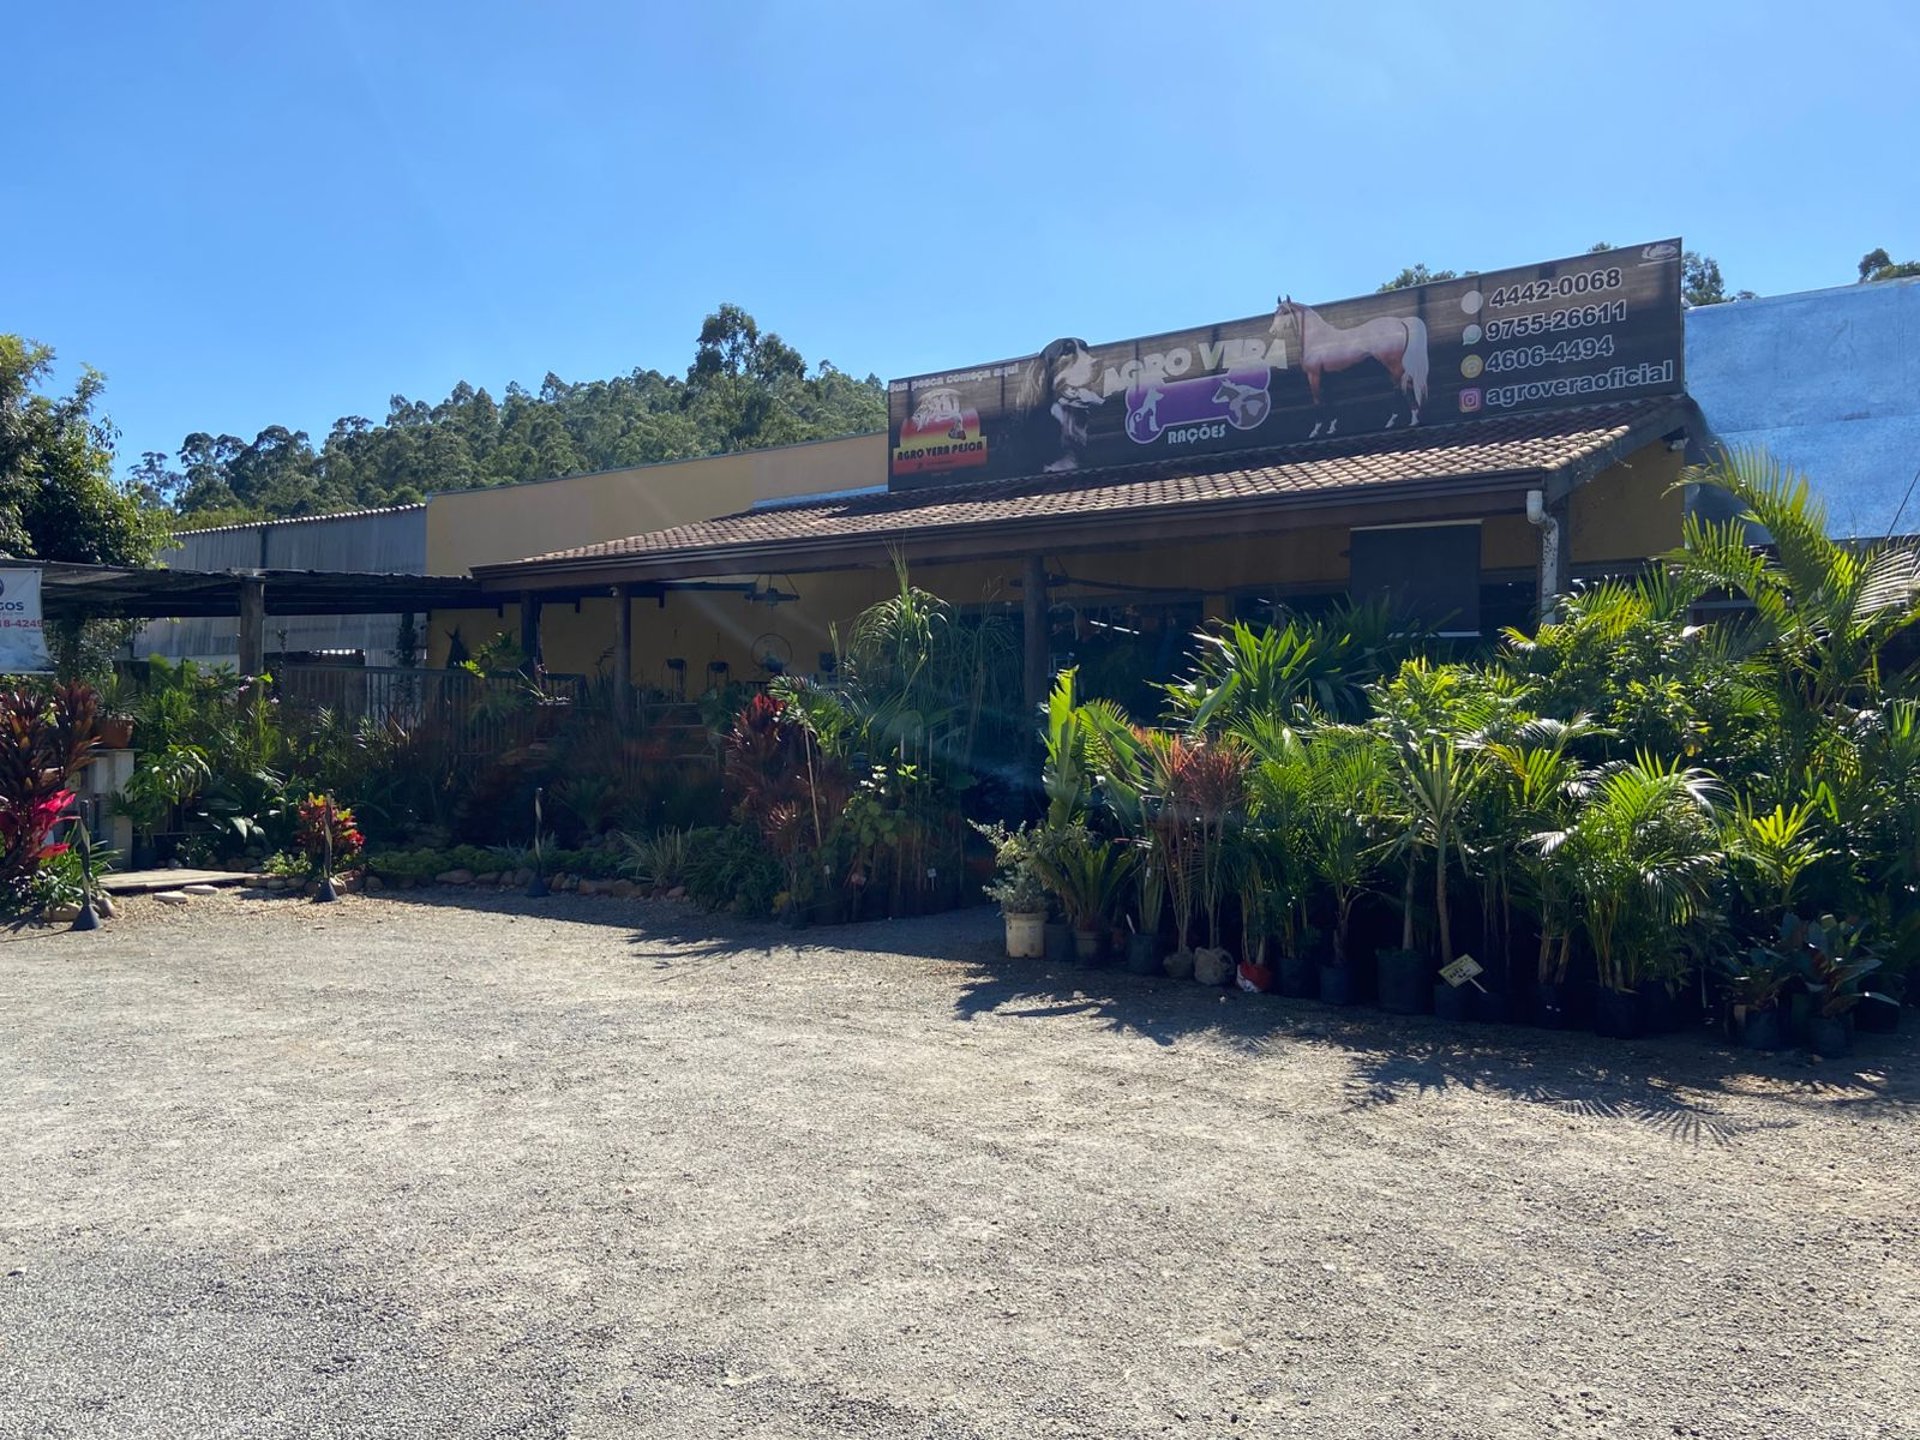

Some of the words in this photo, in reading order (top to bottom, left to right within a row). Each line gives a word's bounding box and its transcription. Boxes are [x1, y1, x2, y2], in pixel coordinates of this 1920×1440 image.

[1489, 267, 1622, 308] 4442-0068
[1485, 299, 1627, 341] 9755-26611
[1103, 347, 1192, 398] AGRO
[1198, 338, 1288, 371] VERA
[1485, 335, 1614, 372] 4606-4494
[946, 370, 991, 384] começa
[1486, 360, 1673, 407] agroveraoficial
[1168, 424, 1226, 444] RAÇÕES
